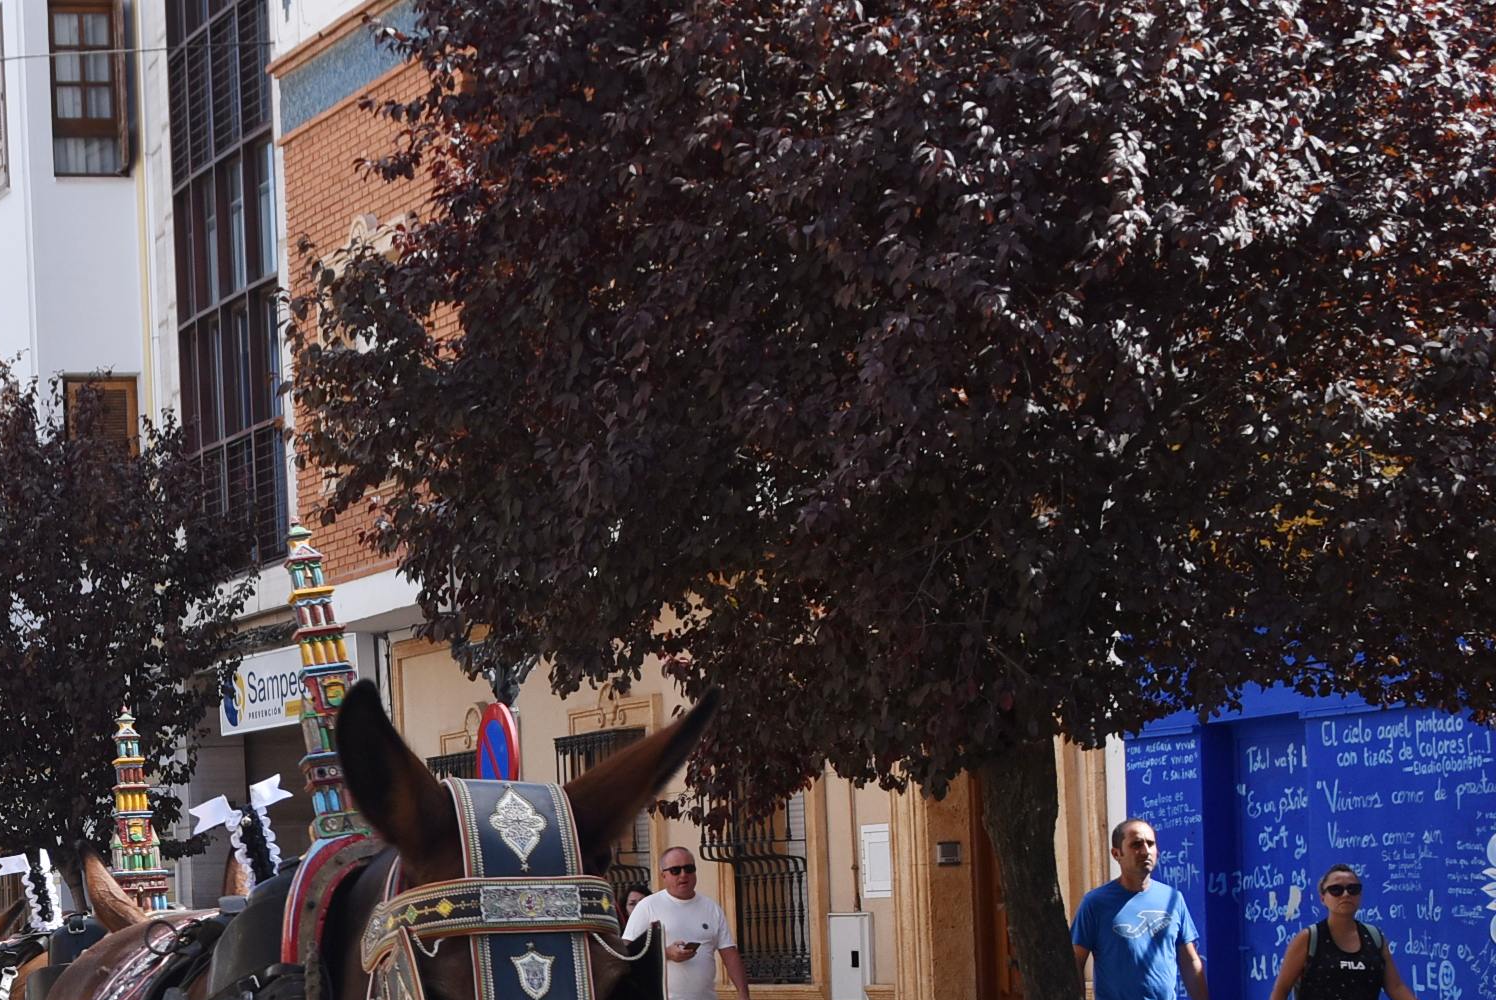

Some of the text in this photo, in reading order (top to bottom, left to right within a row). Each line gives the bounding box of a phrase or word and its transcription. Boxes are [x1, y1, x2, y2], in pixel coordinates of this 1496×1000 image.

[1321, 720, 1338, 747] El
[1416, 711, 1464, 748] pintado
[1337, 751, 1358, 767] con
[1398, 742, 1413, 762] de
[1340, 960, 1366, 970] FILA
